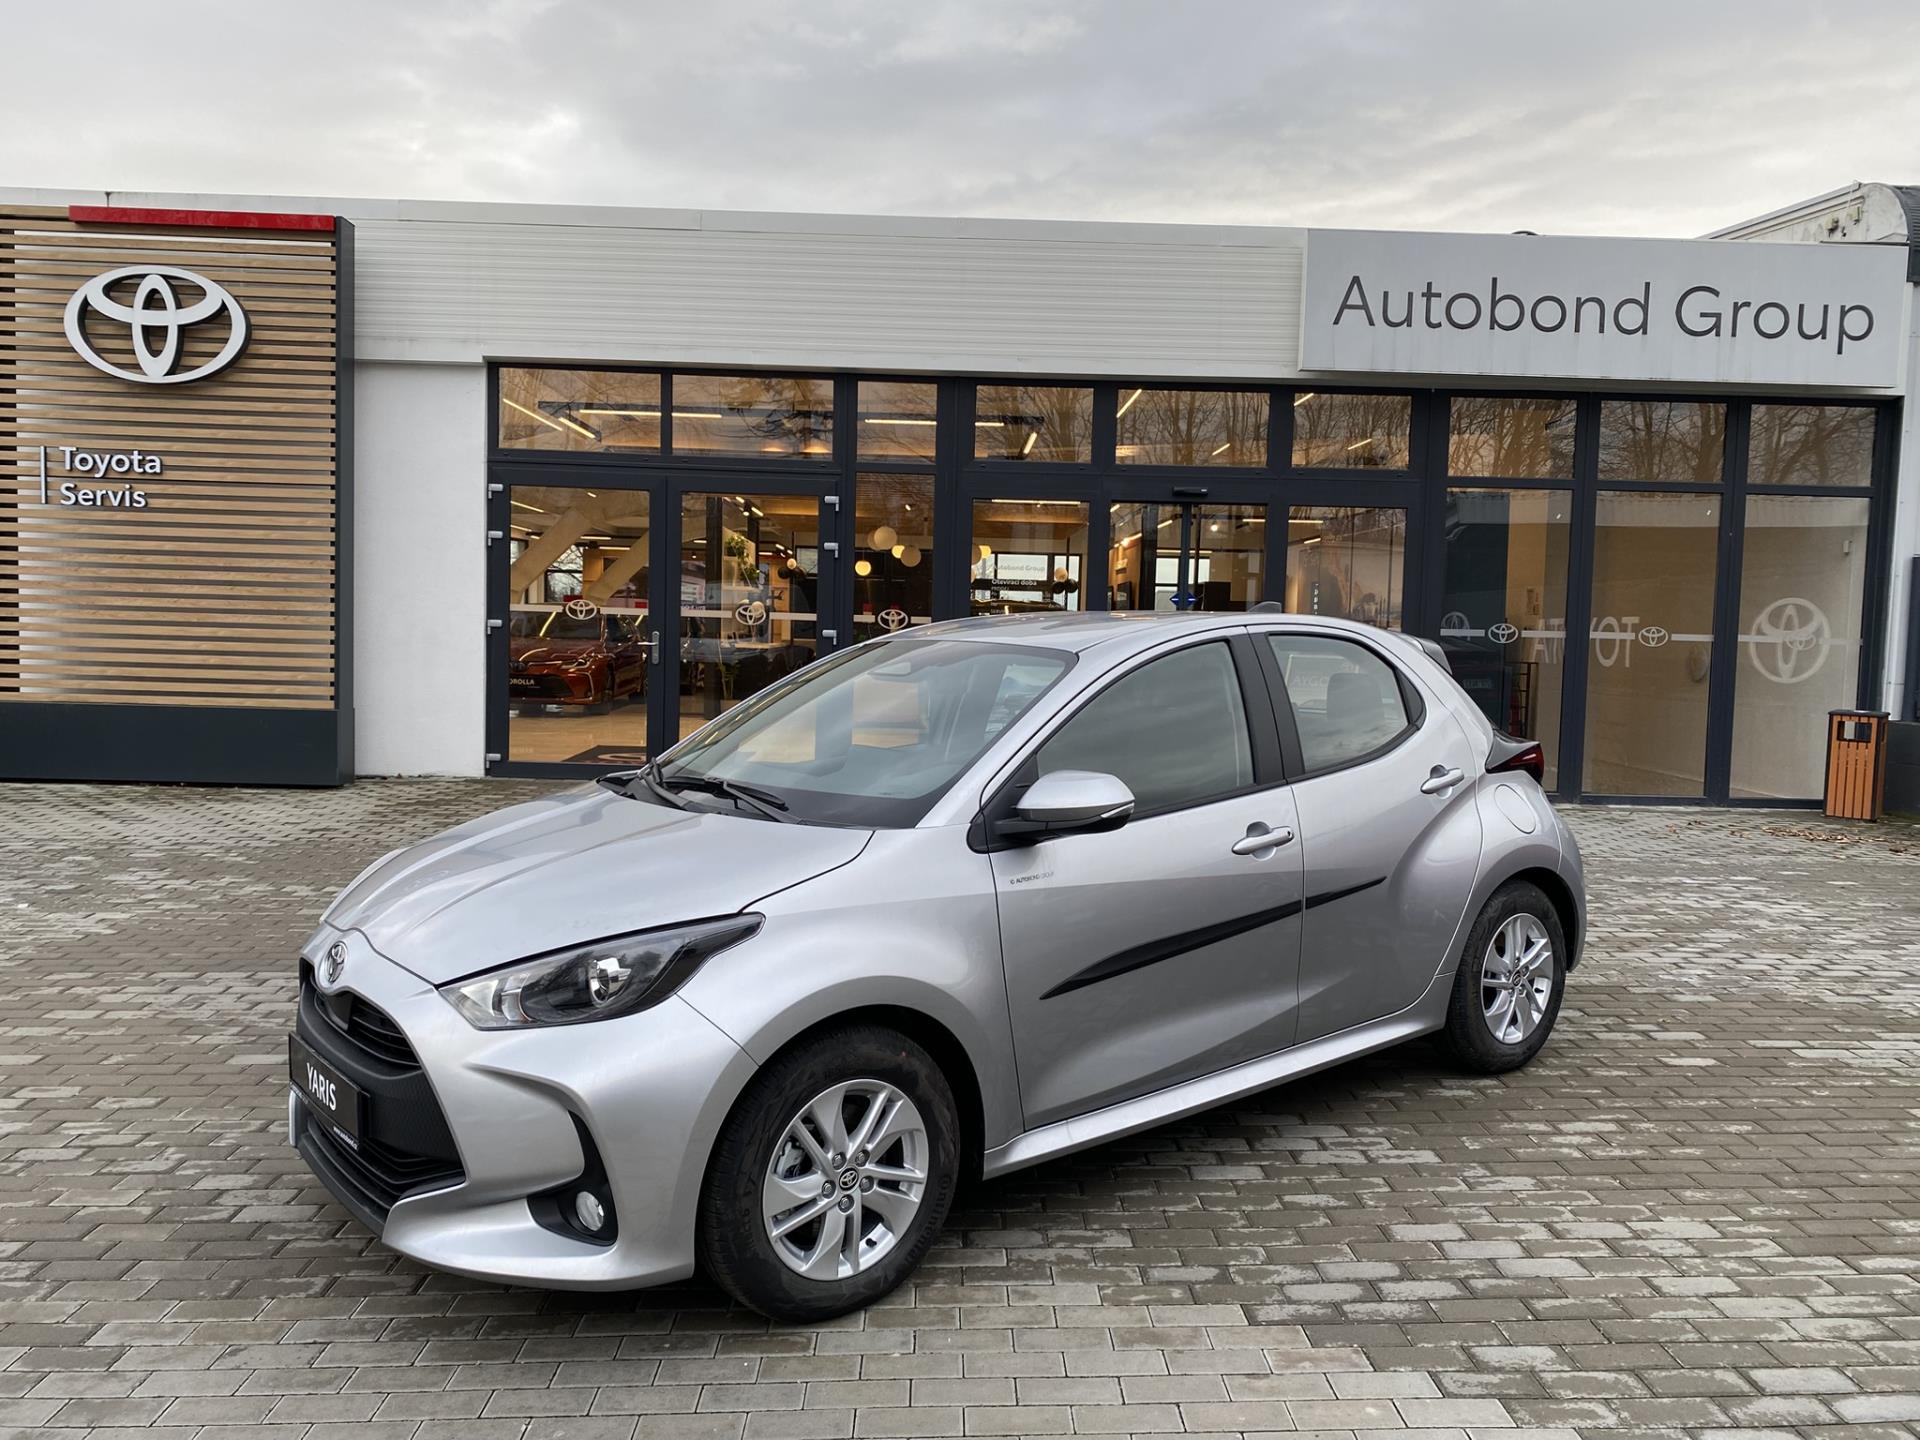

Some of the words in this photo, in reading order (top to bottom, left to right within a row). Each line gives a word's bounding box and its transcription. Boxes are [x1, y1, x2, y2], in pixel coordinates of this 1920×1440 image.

[1333, 275, 1651, 336] Autobond
[1675, 285, 1875, 355] Group
[59, 446, 161, 478] Toyota
[60, 482, 147, 507] Servis
[306, 1062, 337, 1111] YARIS
